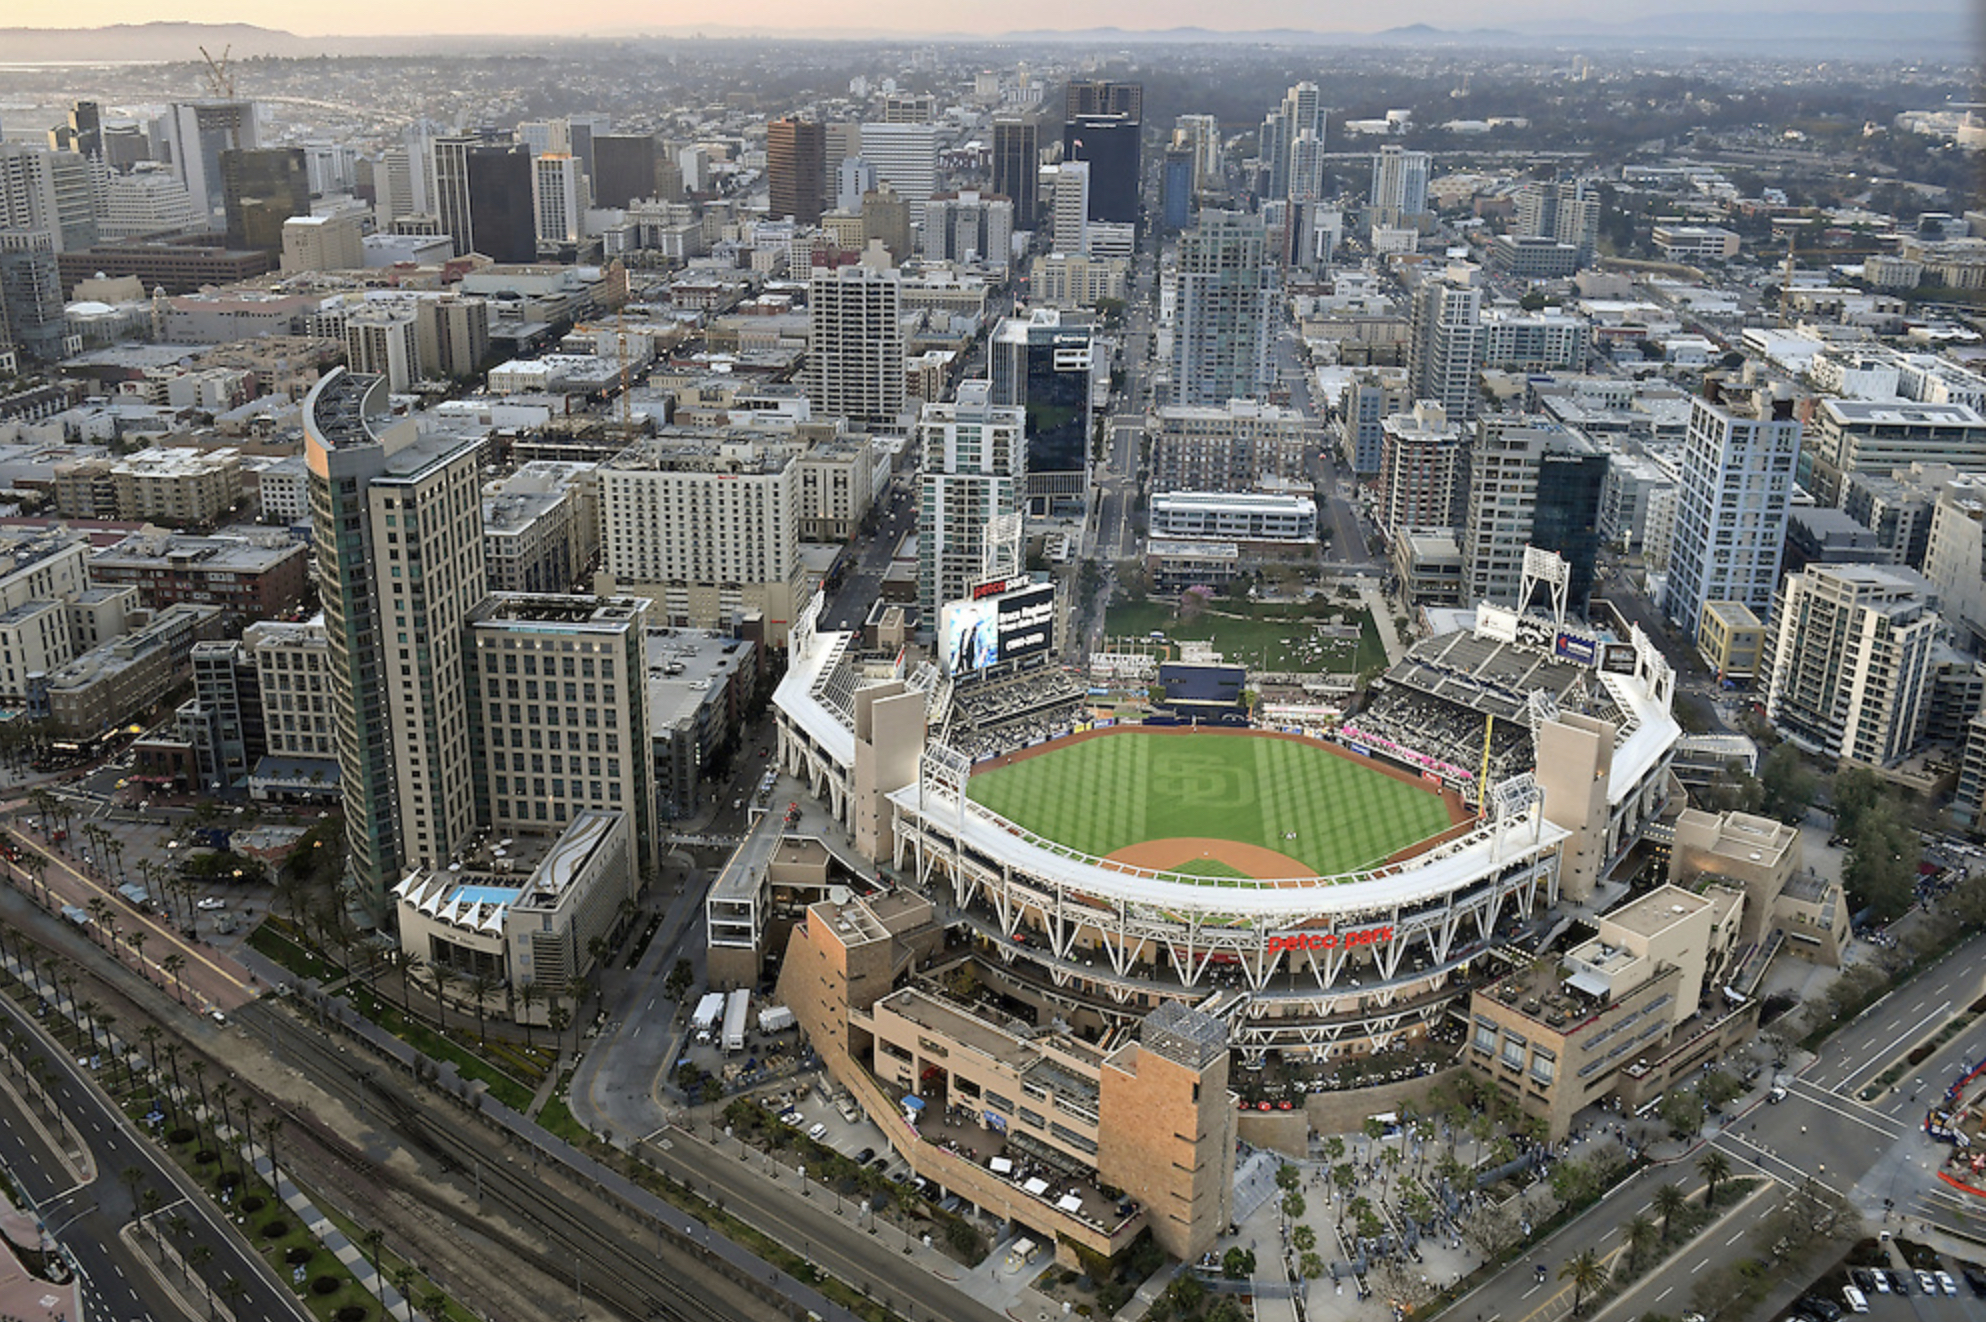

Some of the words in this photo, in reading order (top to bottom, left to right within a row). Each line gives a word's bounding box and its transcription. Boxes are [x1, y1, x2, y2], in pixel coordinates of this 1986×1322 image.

[974, 581, 1005, 600] petco
[1268, 932, 1338, 955] petco
[1345, 926, 1394, 950] park
